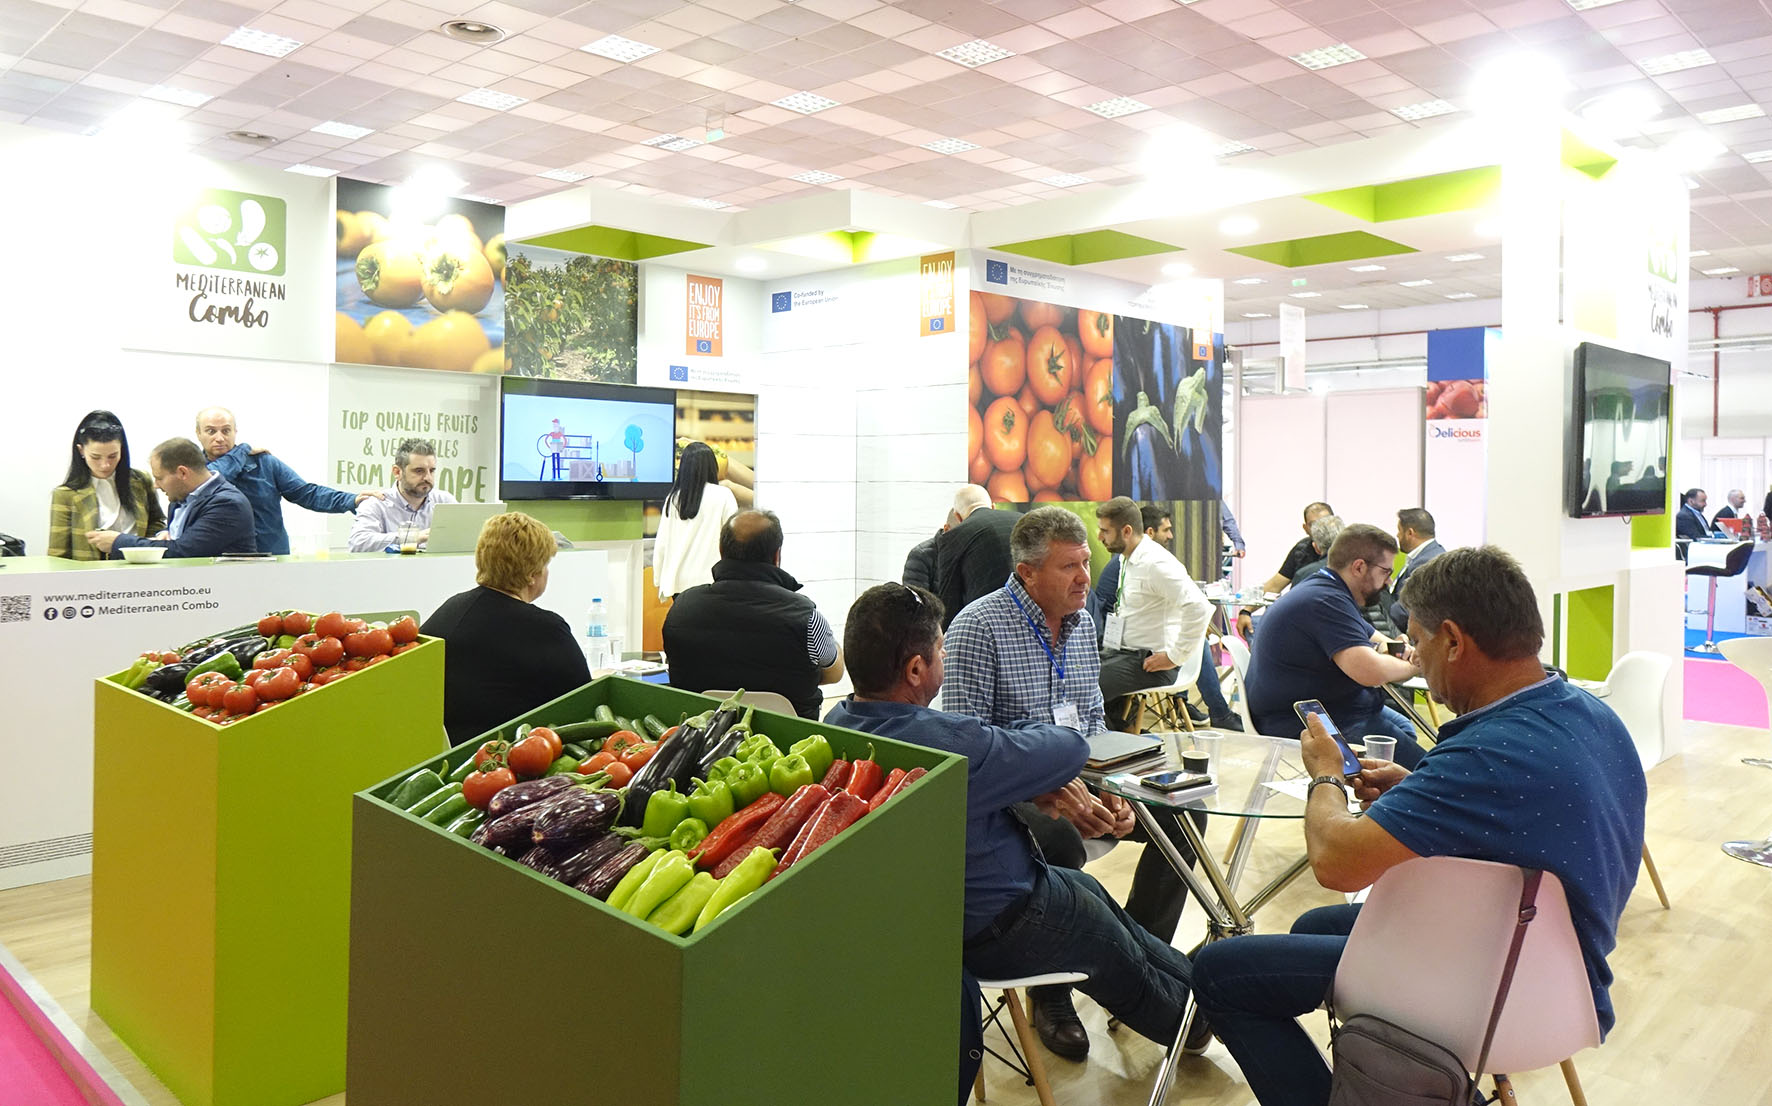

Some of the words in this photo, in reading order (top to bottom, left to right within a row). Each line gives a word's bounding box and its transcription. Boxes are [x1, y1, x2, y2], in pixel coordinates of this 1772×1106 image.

[689, 282, 720, 307] ENJOY
[794, 290, 818, 299] Co-funded
[818, 289, 824, 297] by
[189, 292, 269, 328] Combo
[702, 306, 720, 322] FROM
[689, 320, 720, 340] EUROPE
[342, 410, 369, 430] TOP
[363, 437, 373, 456] &
[336, 460, 384, 487] FROM
[44, 586, 211, 602] www.mediterraneancombo.eu
[99, 603, 179, 616] Mediterranean
[181, 600, 219, 612] Combo
